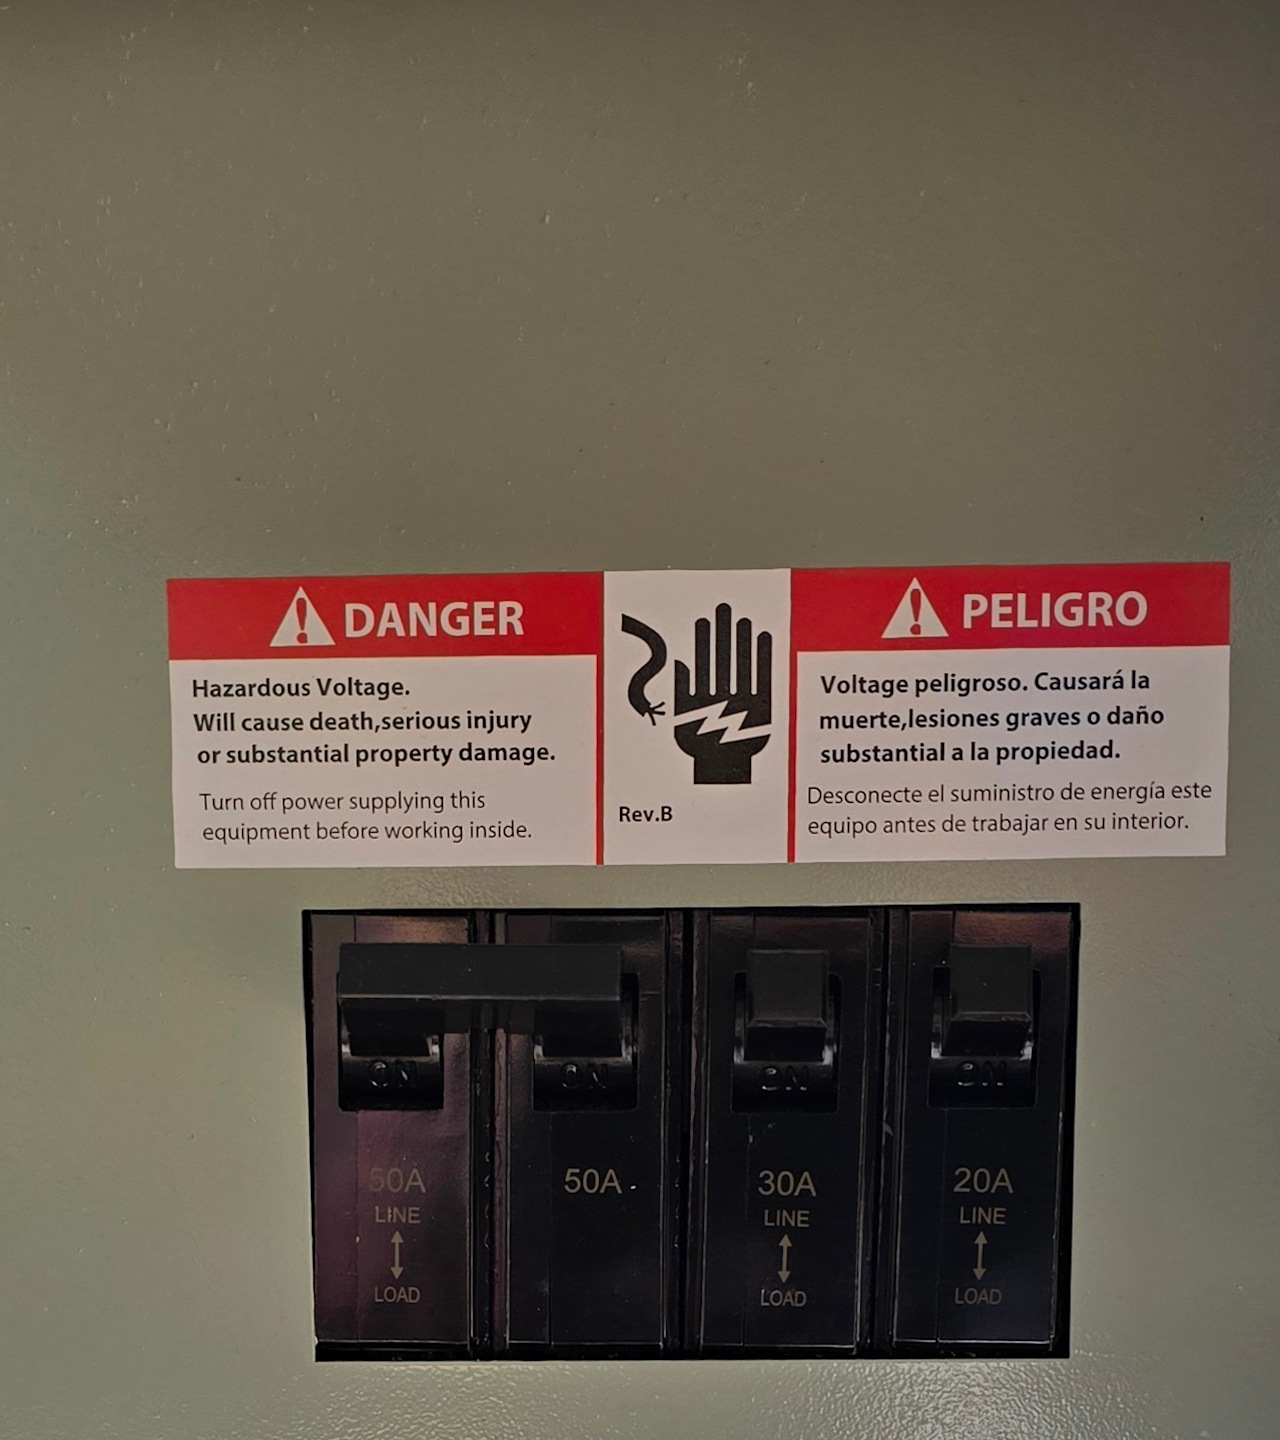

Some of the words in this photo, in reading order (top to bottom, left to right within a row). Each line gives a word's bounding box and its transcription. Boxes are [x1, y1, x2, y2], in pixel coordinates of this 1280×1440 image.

[345, 601, 524, 637] DANGER
[964, 591, 1147, 628] PELIGRO
[193, 678, 310, 697] Hazardous
[316, 677, 409, 700] Voltage.
[821, 674, 908, 698] Voltage
[916, 673, 1027, 697] peligroso.
[1035, 669, 1123, 690] Causará
[1132, 670, 1149, 689] la
[194, 713, 234, 731] Will
[242, 718, 303, 731] cause
[310, 711, 460, 733] death,serious
[467, 710, 531, 734] injury
[820, 709, 999, 731] muerte,lesiones
[1006, 712, 1080, 731] graves
[1087, 712, 1100, 725] o
[1107, 706, 1164, 724] daño
[198, 751, 221, 763] or
[227, 744, 348, 763] substantial
[356, 745, 453, 767] property
[459, 742, 555, 765] damage.
[821, 742, 945, 763] substantial
[952, 748, 963, 761] a
[971, 742, 988, 760] la
[997, 739, 1120, 765] propiedad.
[199, 794, 244, 810] Turn
[250, 792, 277, 810] off
[283, 797, 344, 814] power
[350, 791, 443, 814] supplying
[451, 791, 484, 808] this
[808, 787, 922, 804] Desconecte
[928, 784, 943, 802] el
[951, 784, 1054, 802] suministro
[1061, 782, 1084, 800] de
[1091, 781, 1164, 804] energía
[1172, 783, 1211, 798] este
[620, 806, 672, 822] Rev.B
[809, 817, 877, 838] equipo
[883, 817, 935, 833] antes
[942, 814, 966, 832] de
[972, 813, 1048, 836] trabajar
[1054, 818, 1077, 830] en
[1085, 818, 1105, 830] su
[1113, 812, 1188, 829] interior.
[203, 824, 310, 845] equipment
[317, 821, 379, 839] before
[385, 821, 462, 843] working
[471, 820, 532, 838] inside.
[371, 1061, 417, 1088] ON
[562, 1063, 607, 1089] ON
[370, 1168, 426, 1193] 50A
[564, 1168, 622, 1194] 50A
[758, 1170, 816, 1197] 30A
[954, 1167, 1013, 1194] 20A
[375, 1206, 420, 1224] LINE
[764, 1209, 810, 1228] LINE
[960, 1206, 1006, 1225] LINE
[375, 1286, 420, 1304] LOAD
[761, 1289, 807, 1307] LOAD
[955, 1288, 1002, 1305] LOAD
